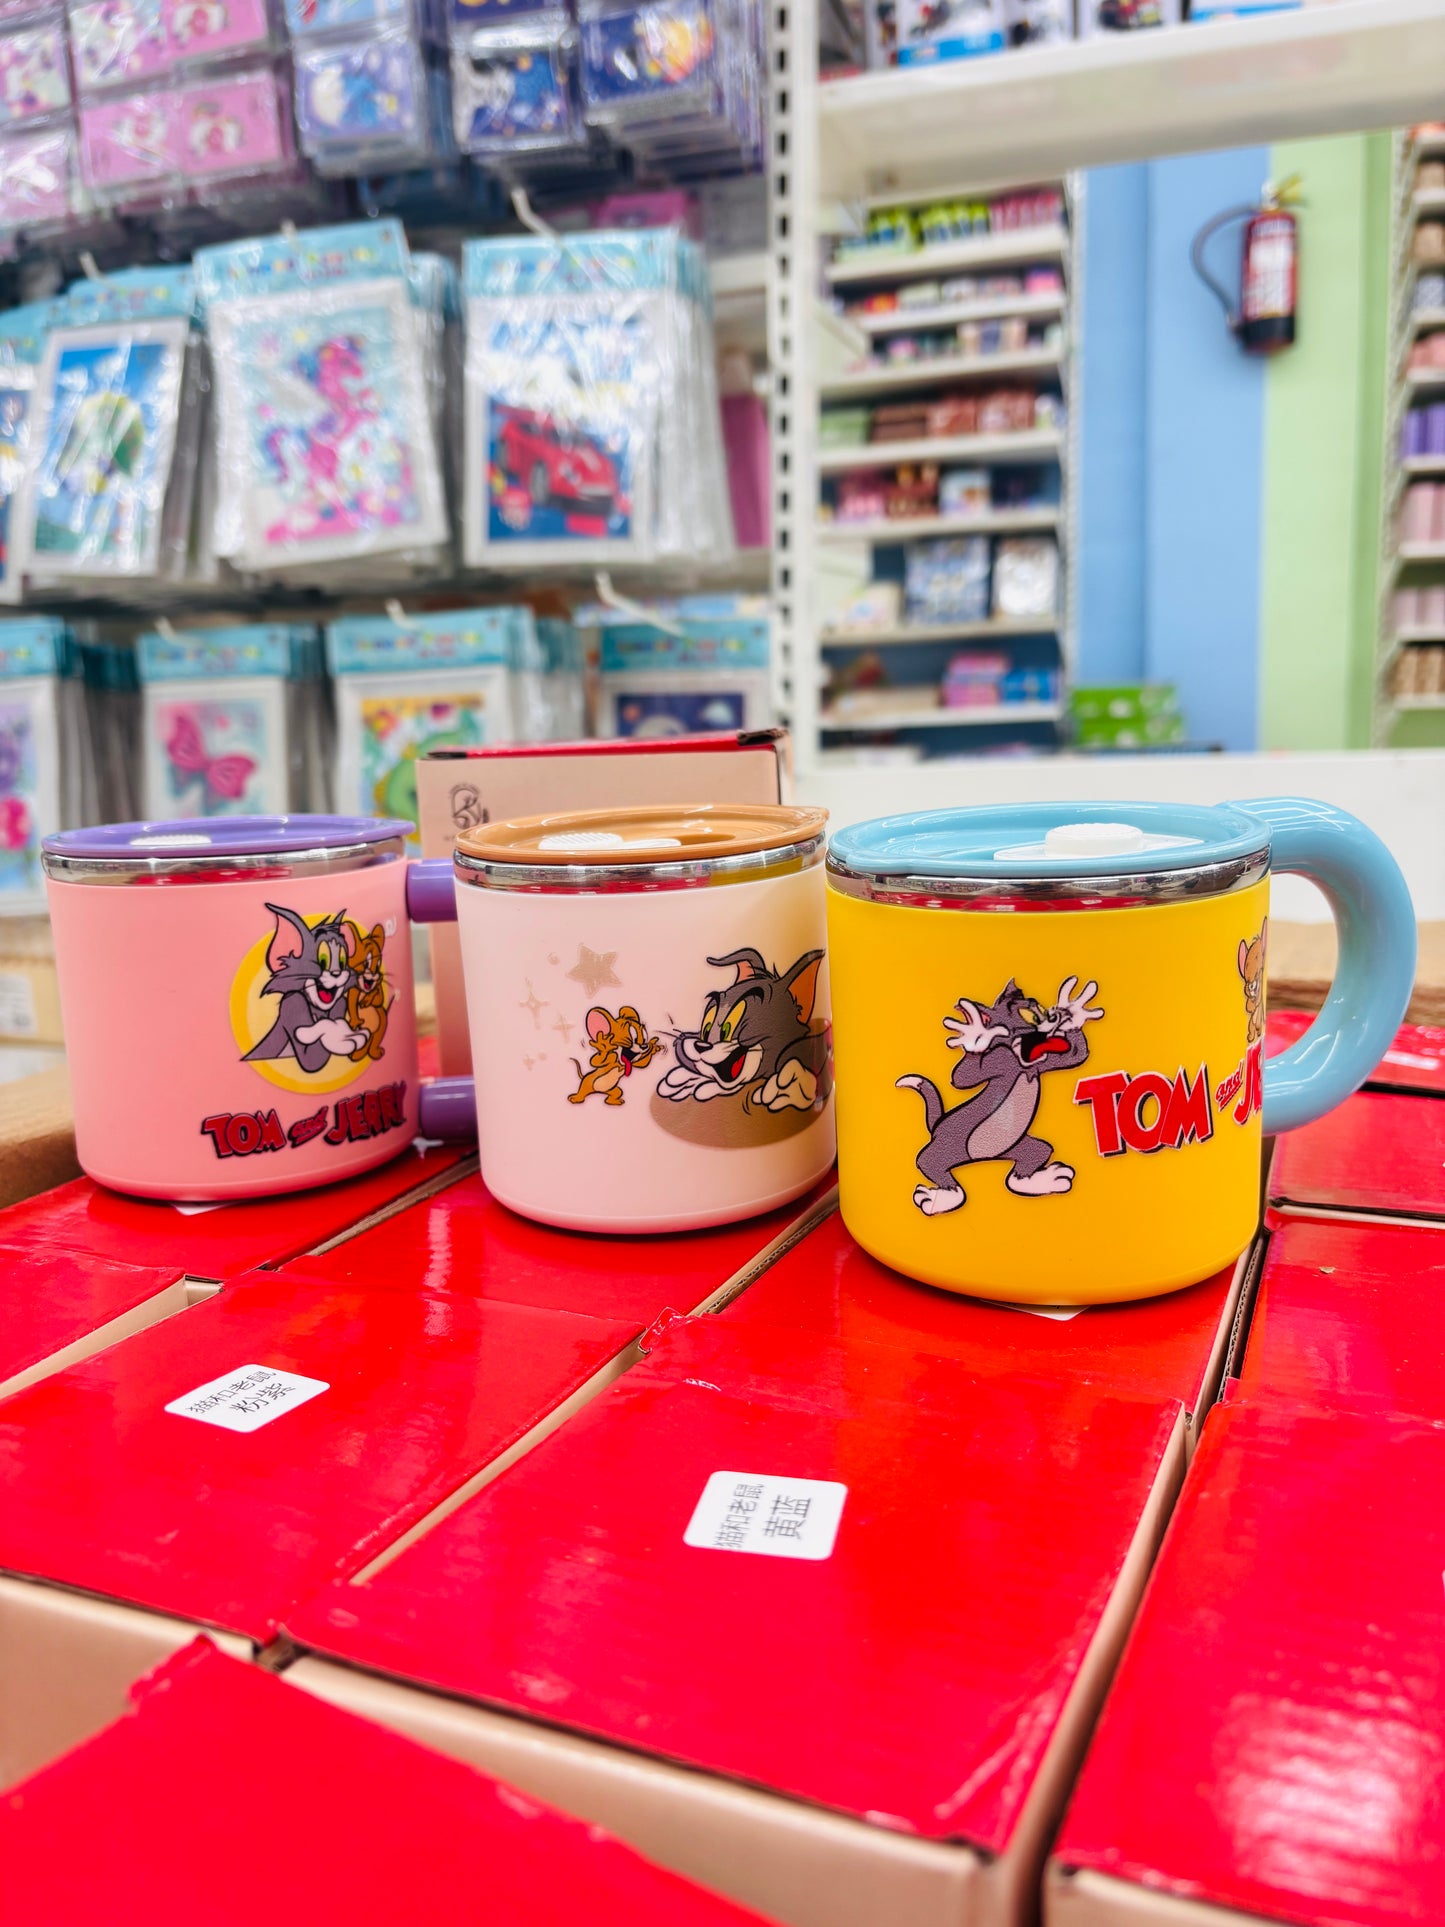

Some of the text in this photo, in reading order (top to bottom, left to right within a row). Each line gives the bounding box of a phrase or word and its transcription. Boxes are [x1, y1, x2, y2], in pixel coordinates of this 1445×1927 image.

[1073, 1061, 1214, 1157] TOM
[1215, 1058, 1245, 1112] and
[201, 1109, 287, 1158] TOM
[185, 1370, 277, 1414] 猫和老鼠
[229, 1383, 296, 1413] 粉紫
[712, 1483, 765, 1548] 猫和老鼠
[762, 1495, 812, 1541] 黄蓝
